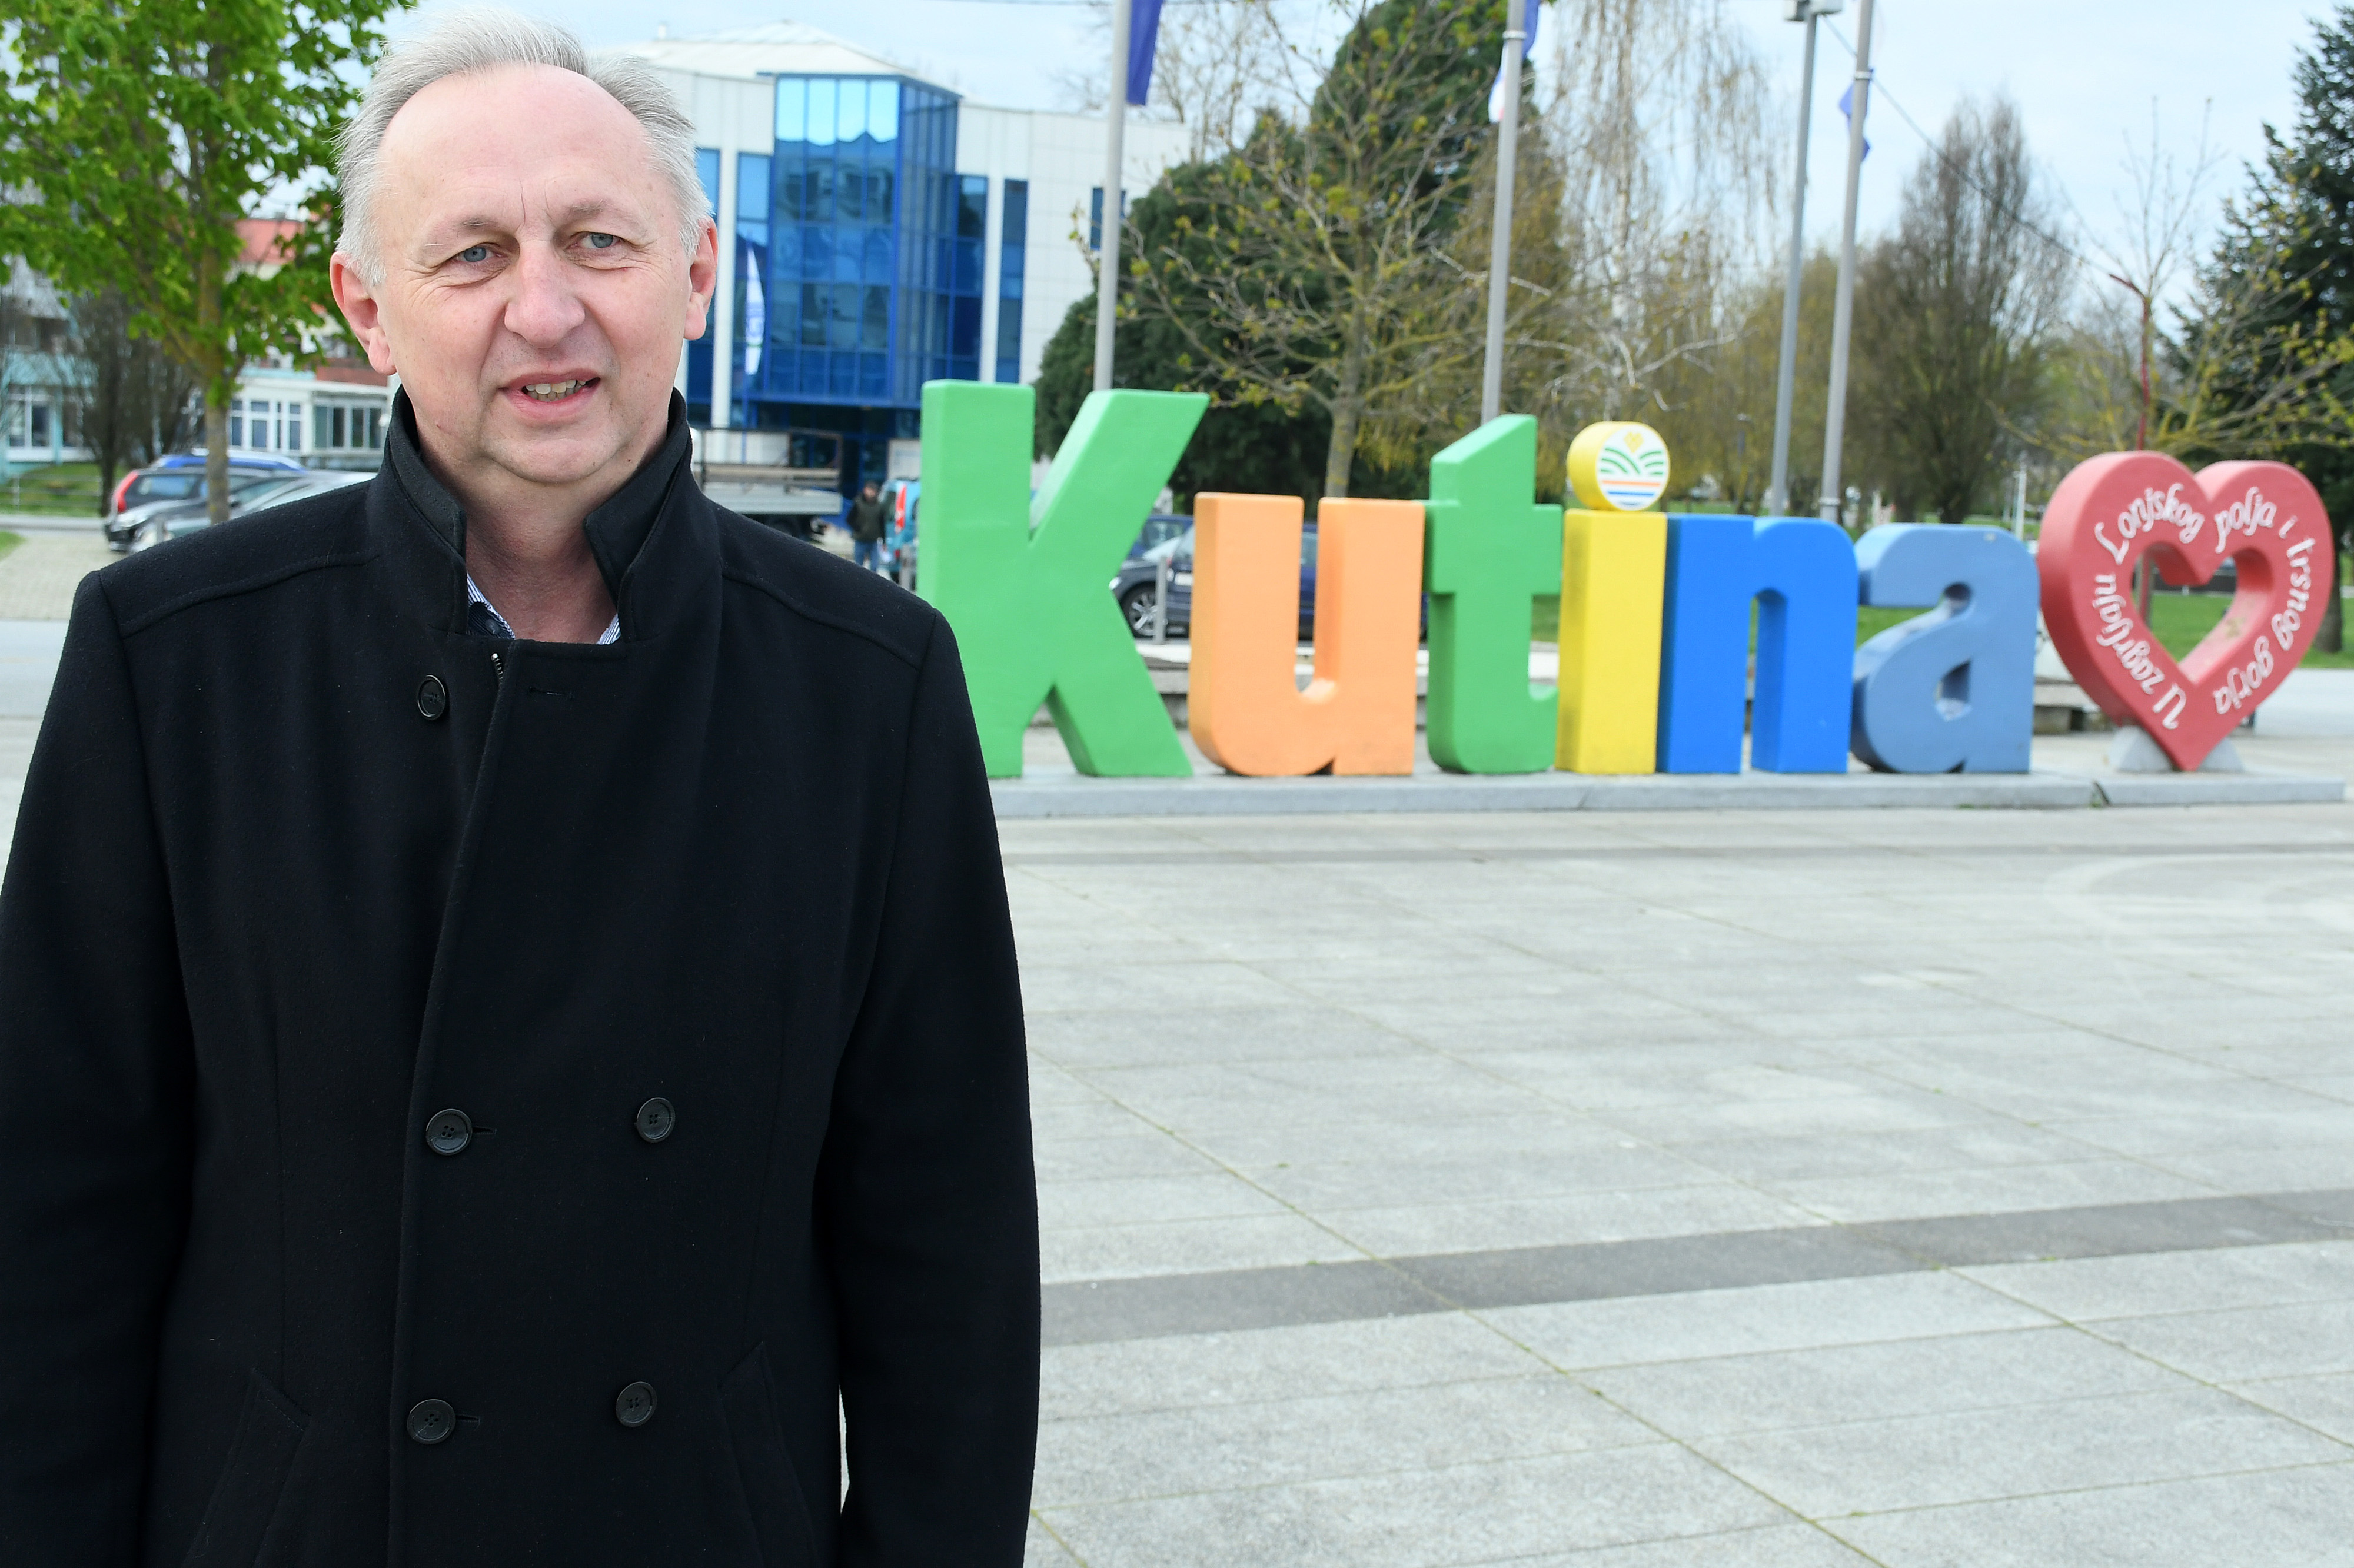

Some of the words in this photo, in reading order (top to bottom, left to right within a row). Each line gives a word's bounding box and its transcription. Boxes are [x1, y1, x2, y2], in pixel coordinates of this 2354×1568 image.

[2094, 483, 2205, 565] Lonjskog
[2214, 486, 2277, 554] polja
[2279, 515, 2298, 539] i
[916, 379, 2040, 777] Kutina
[2272, 538, 2316, 651] trsnog
[2092, 574, 2165, 695] zagrljaju
[2213, 635, 2274, 714] gorja
[2152, 683, 2187, 730] U
